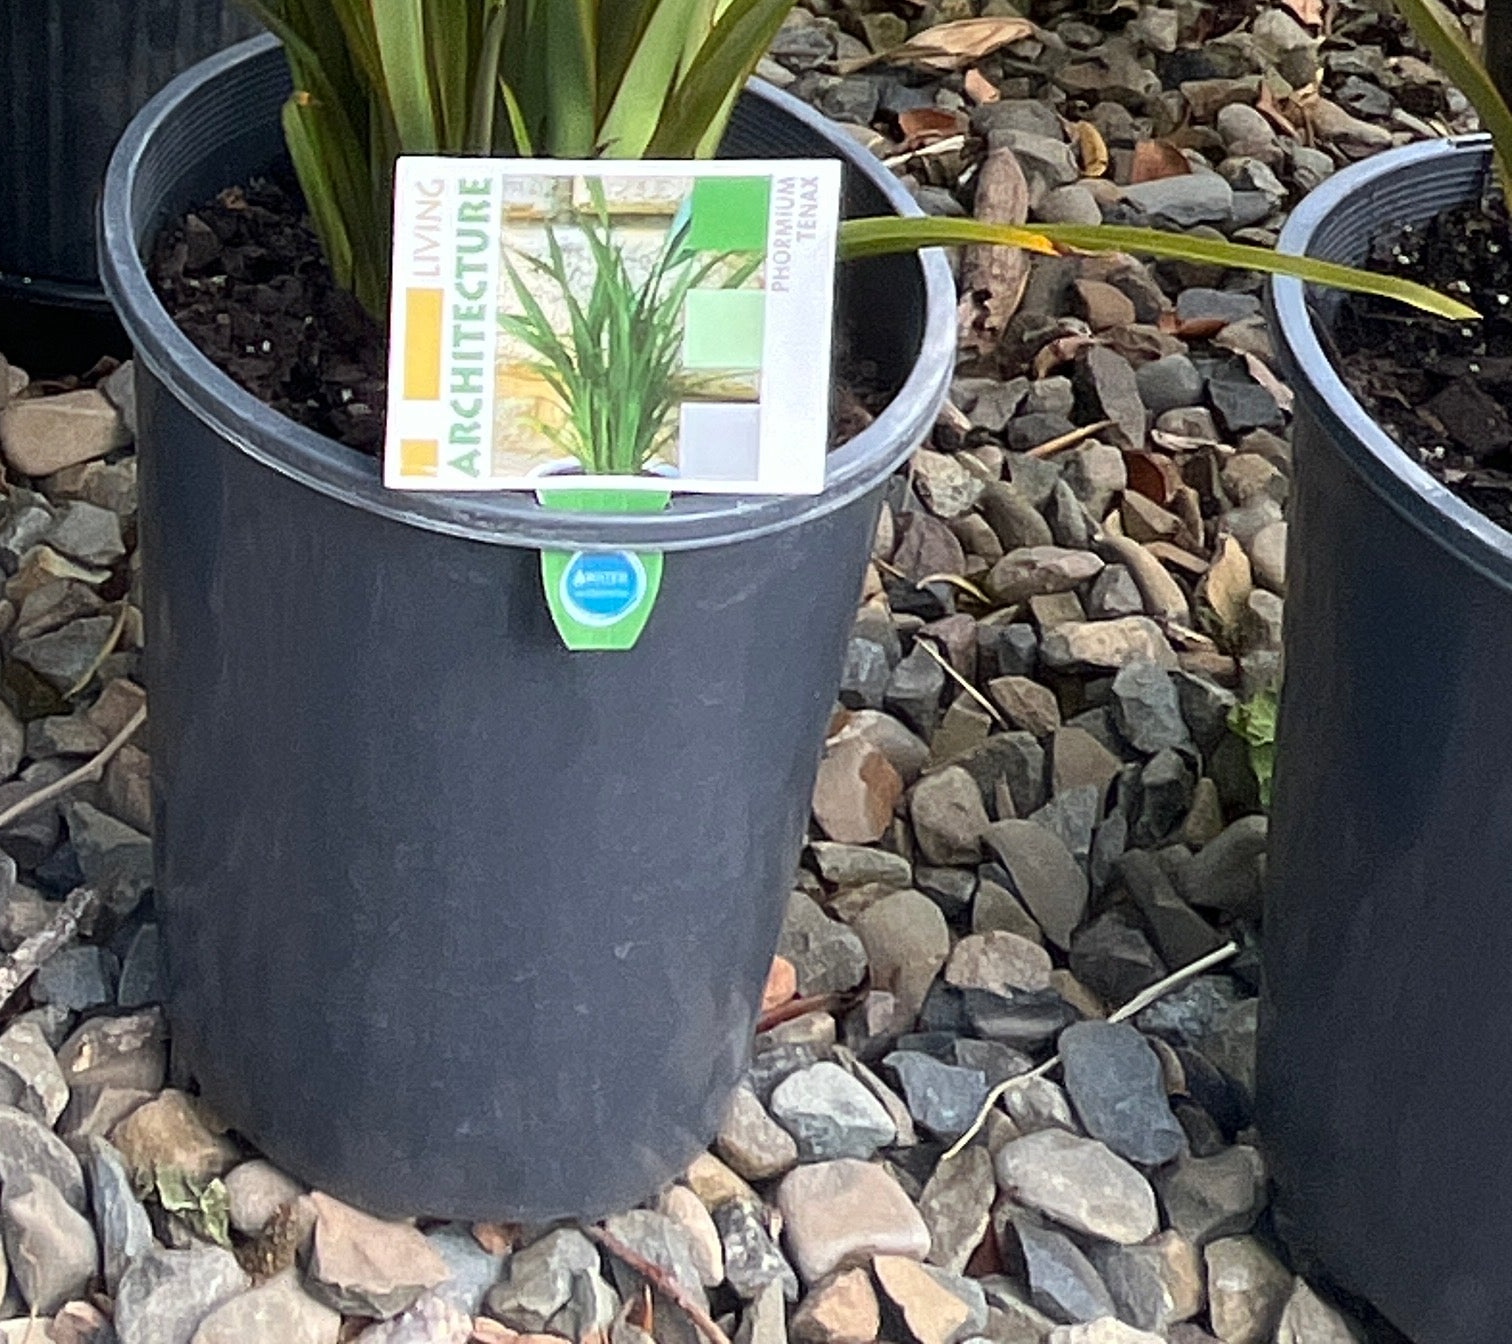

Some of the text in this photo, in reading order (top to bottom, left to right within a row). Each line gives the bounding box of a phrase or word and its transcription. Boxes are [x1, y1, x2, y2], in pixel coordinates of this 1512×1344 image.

[412, 179, 445, 278] LIVING
[771, 176, 798, 293] PHORMIUM
[796, 176, 819, 242] TENAX
[447, 177, 493, 478] ARCHITECTURE
